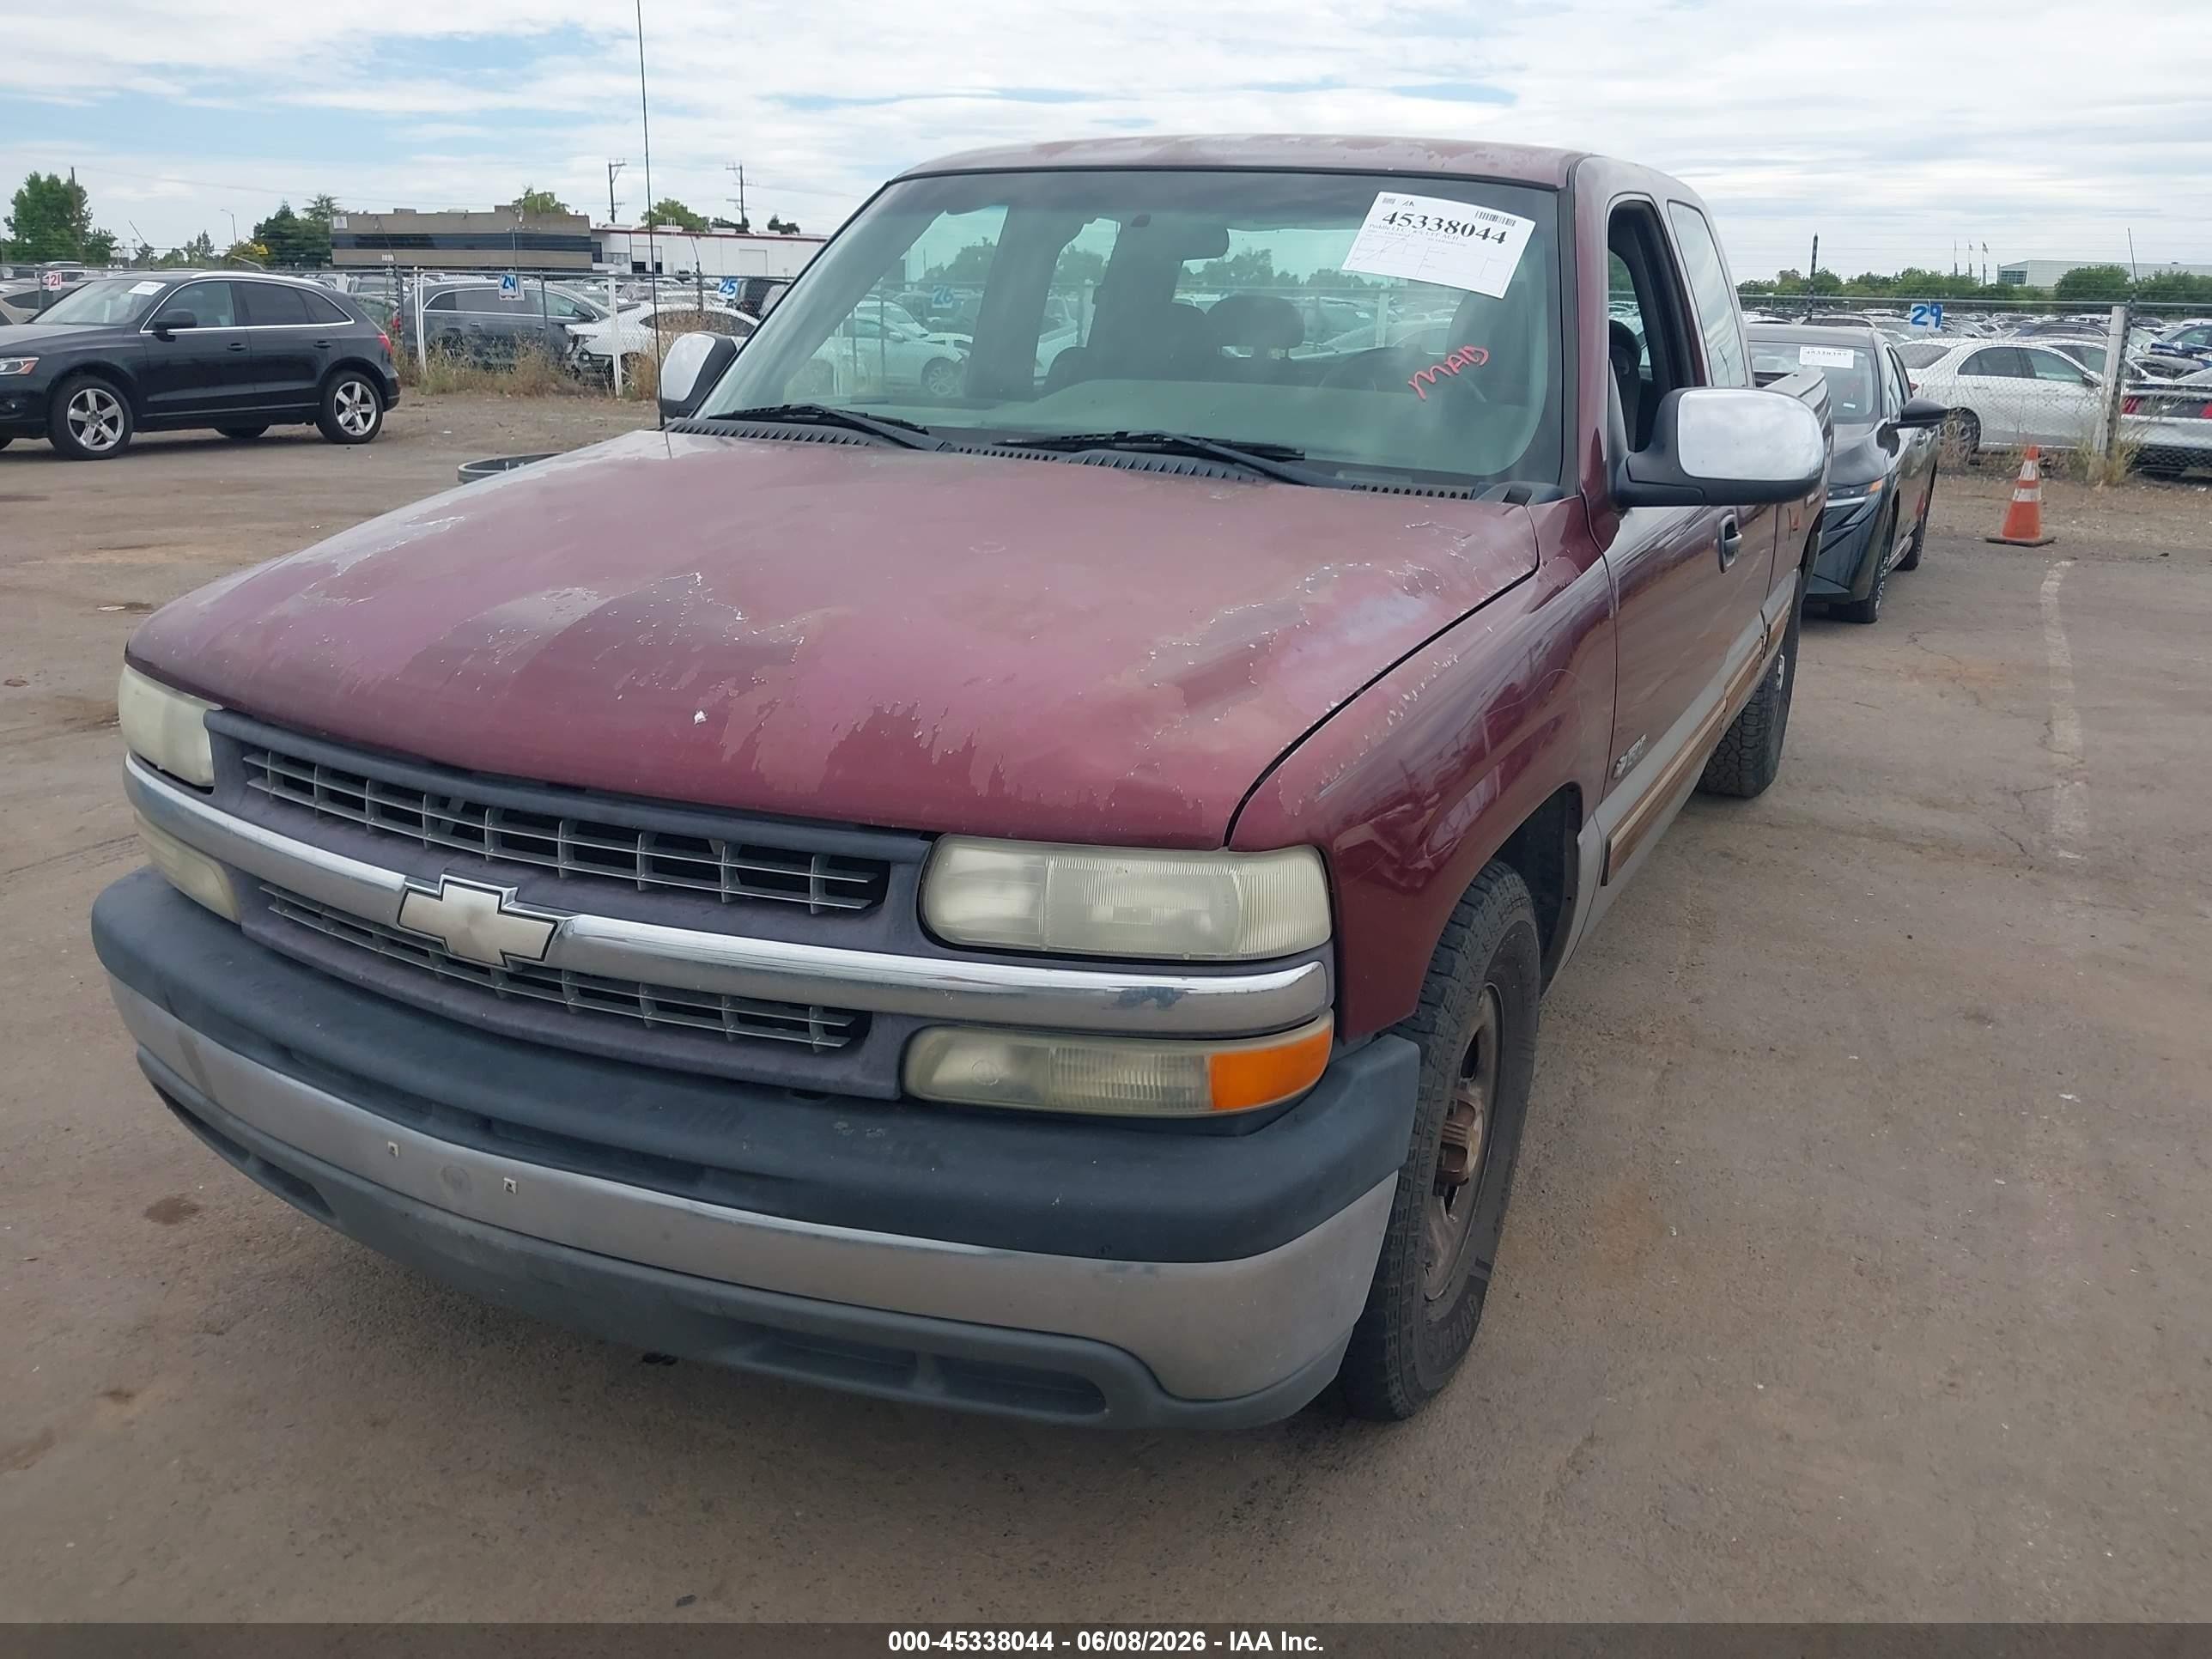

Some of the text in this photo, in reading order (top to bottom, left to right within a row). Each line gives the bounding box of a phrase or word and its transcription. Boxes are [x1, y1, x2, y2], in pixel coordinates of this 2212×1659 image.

[1382, 211, 1509, 245] 45338044
[50, 274, 60, 286] 21
[501, 275, 516, 292] 24
[719, 276, 738, 295] 25
[1911, 304, 1942, 329] 29
